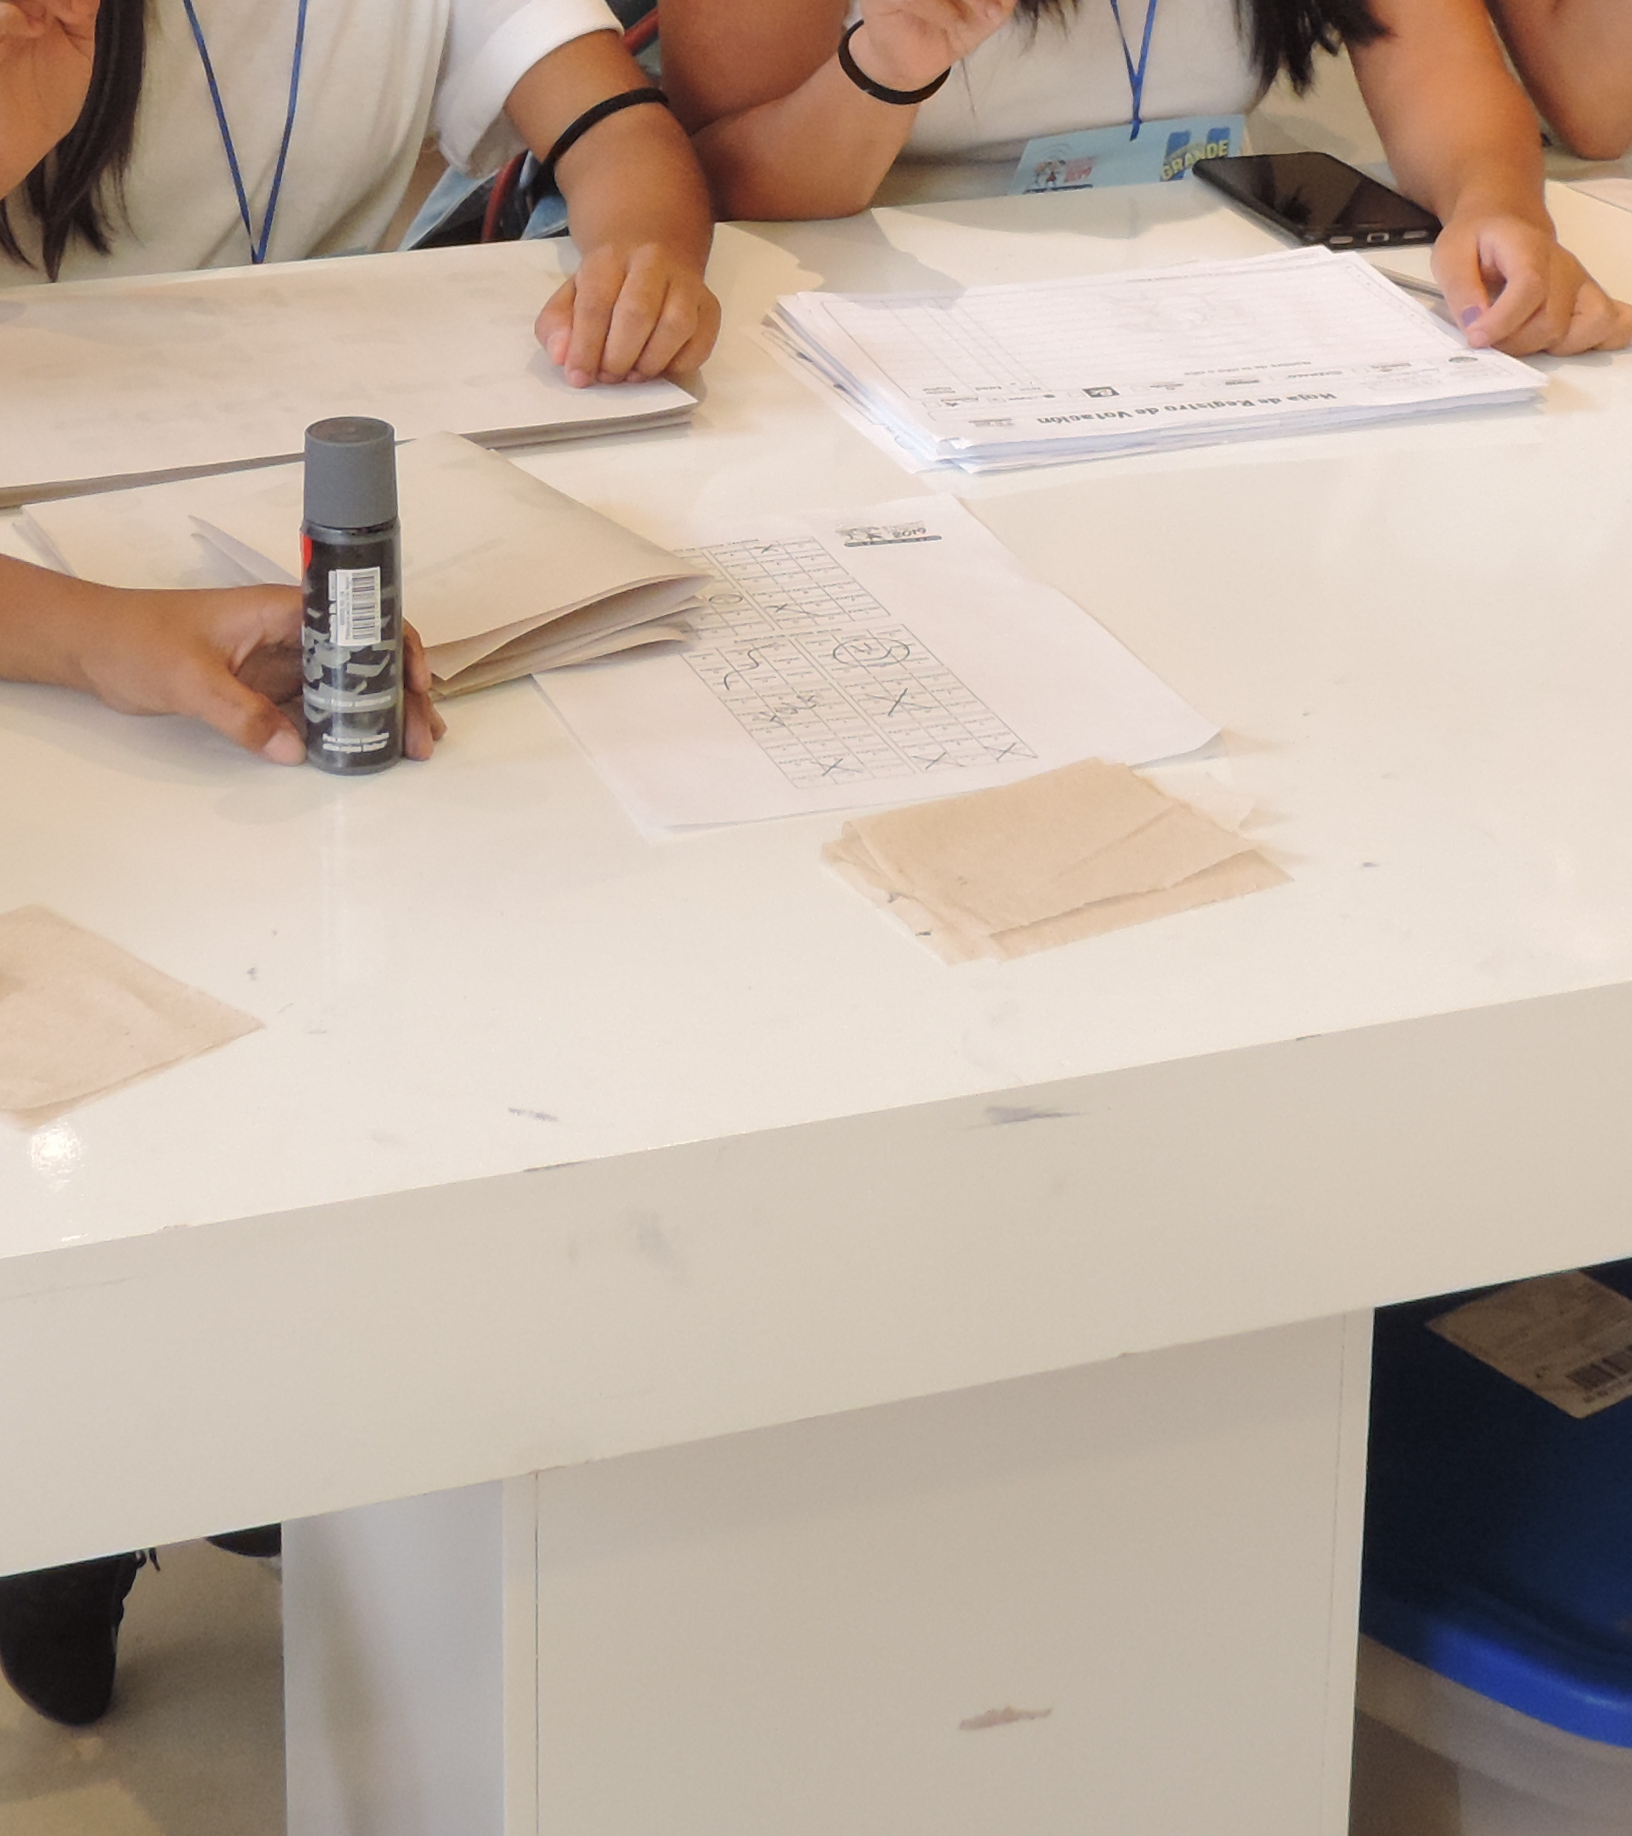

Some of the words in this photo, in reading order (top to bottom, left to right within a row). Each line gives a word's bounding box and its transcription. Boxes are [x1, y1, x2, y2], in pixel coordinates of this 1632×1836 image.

[1159, 139, 1230, 182] GRANDE
[1258, 395, 1282, 405] de
[1286, 392, 1337, 402] Hoja
[1134, 406, 1160, 416] de
[1167, 400, 1256, 413] Registro
[1036, 410, 1132, 425] Votación
